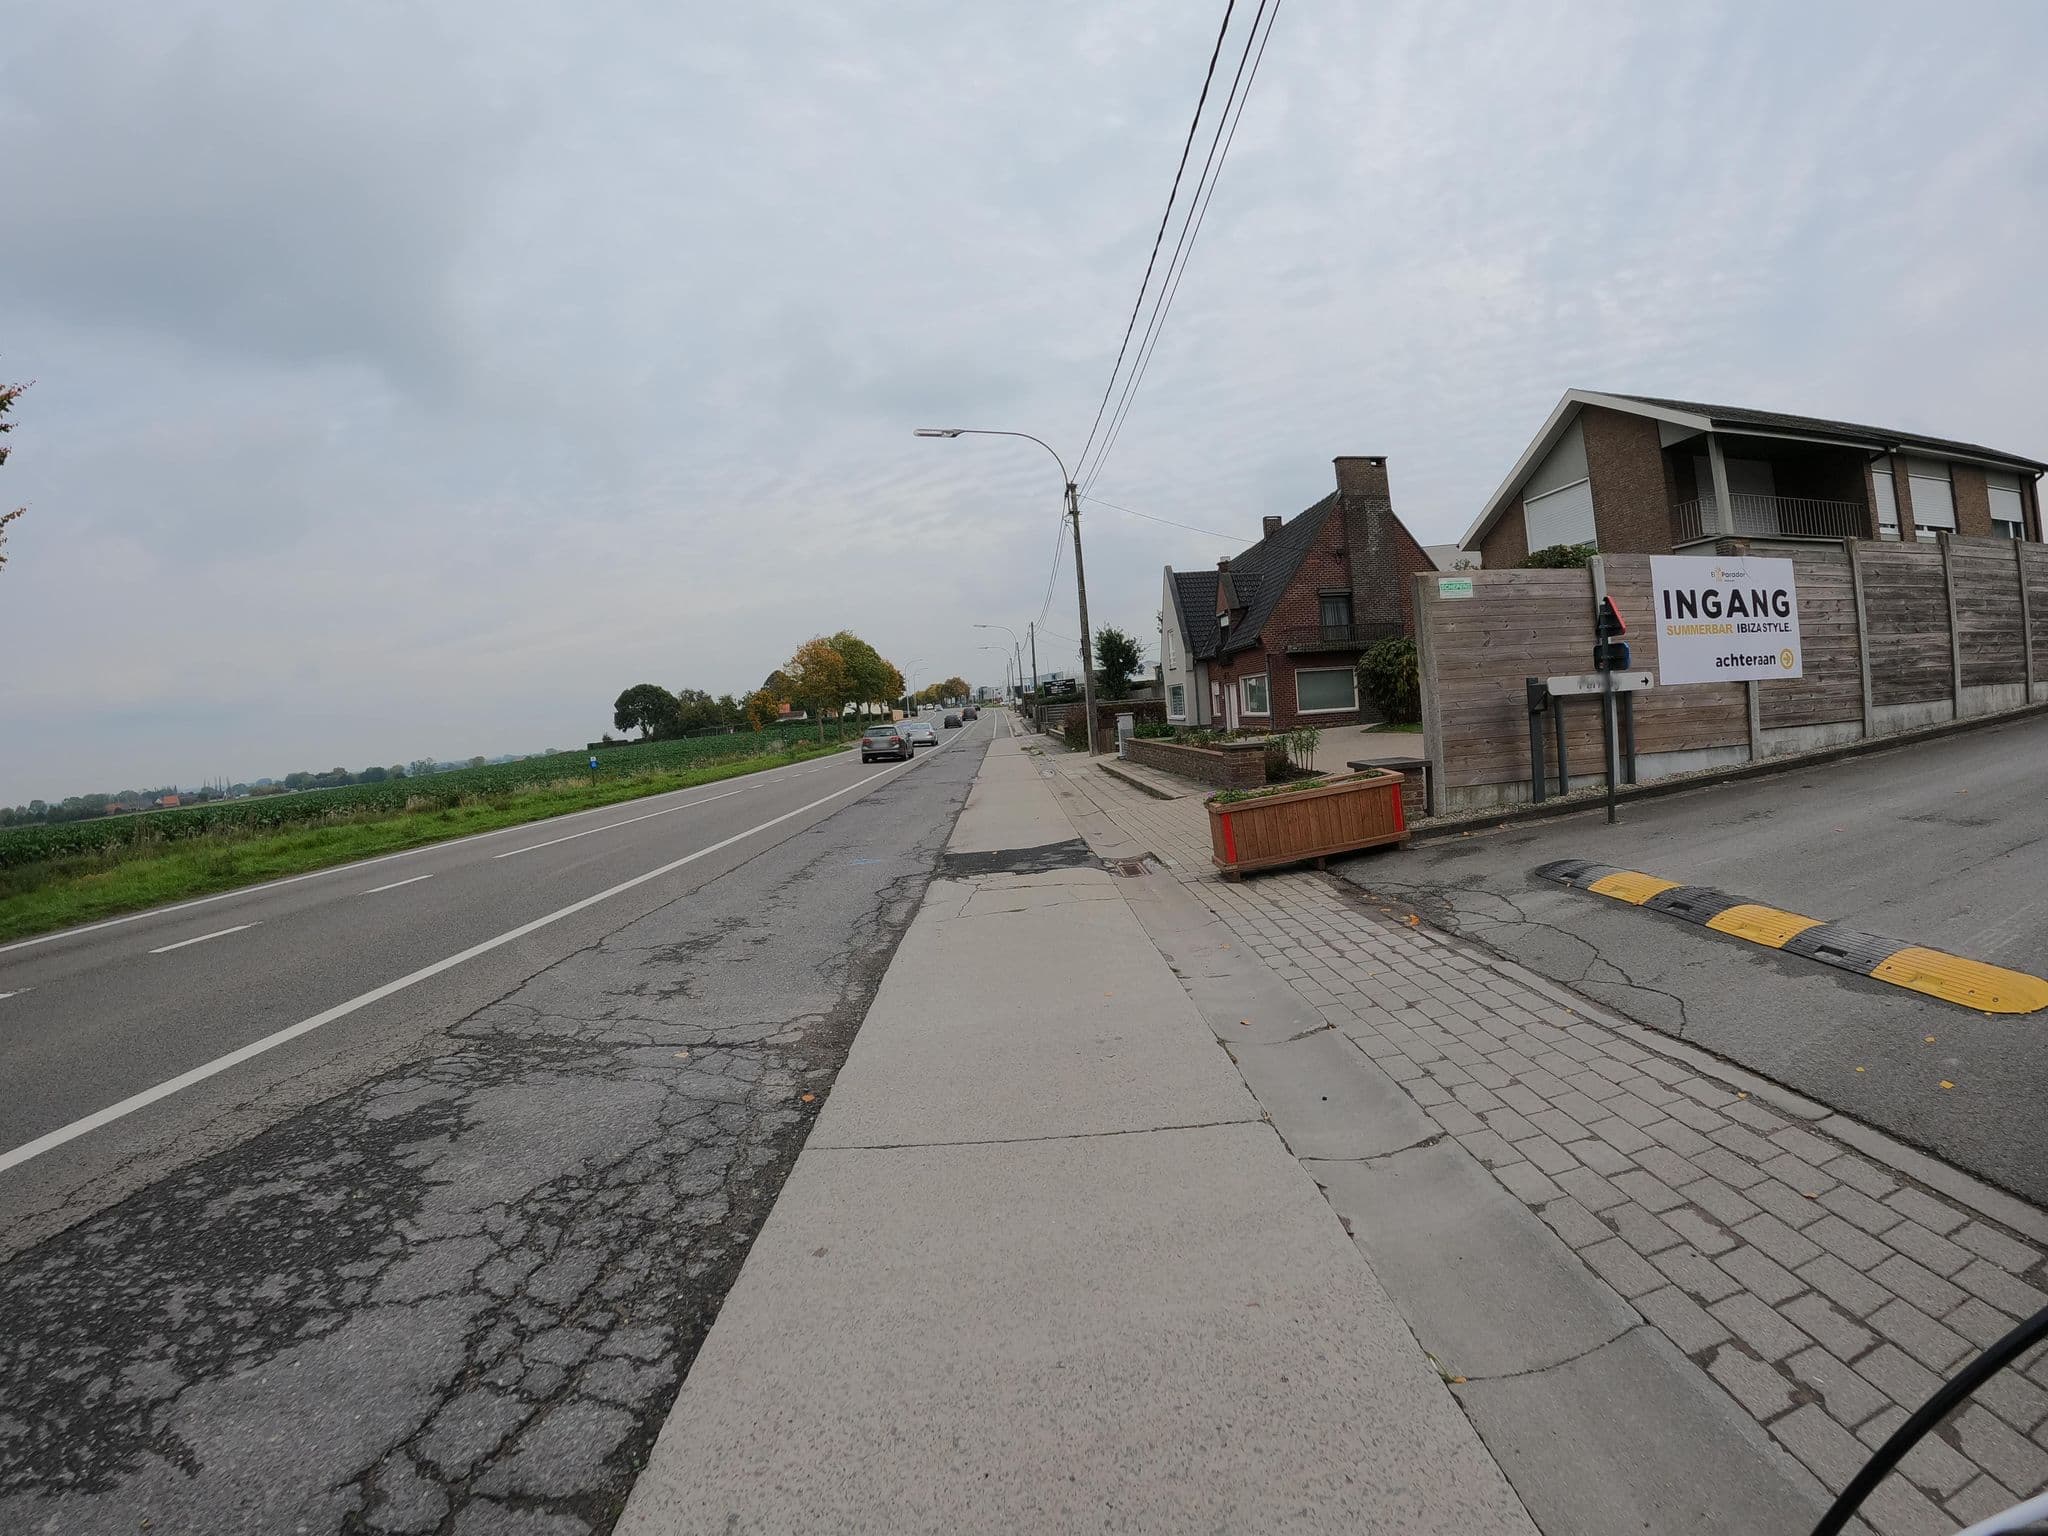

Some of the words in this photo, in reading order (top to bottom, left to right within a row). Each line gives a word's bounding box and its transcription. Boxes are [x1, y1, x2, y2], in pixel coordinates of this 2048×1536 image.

[1663, 589, 1791, 619] INGANG
[1666, 623, 1733, 636] SUMMERBAR
[1715, 653, 1776, 668] achteraan
